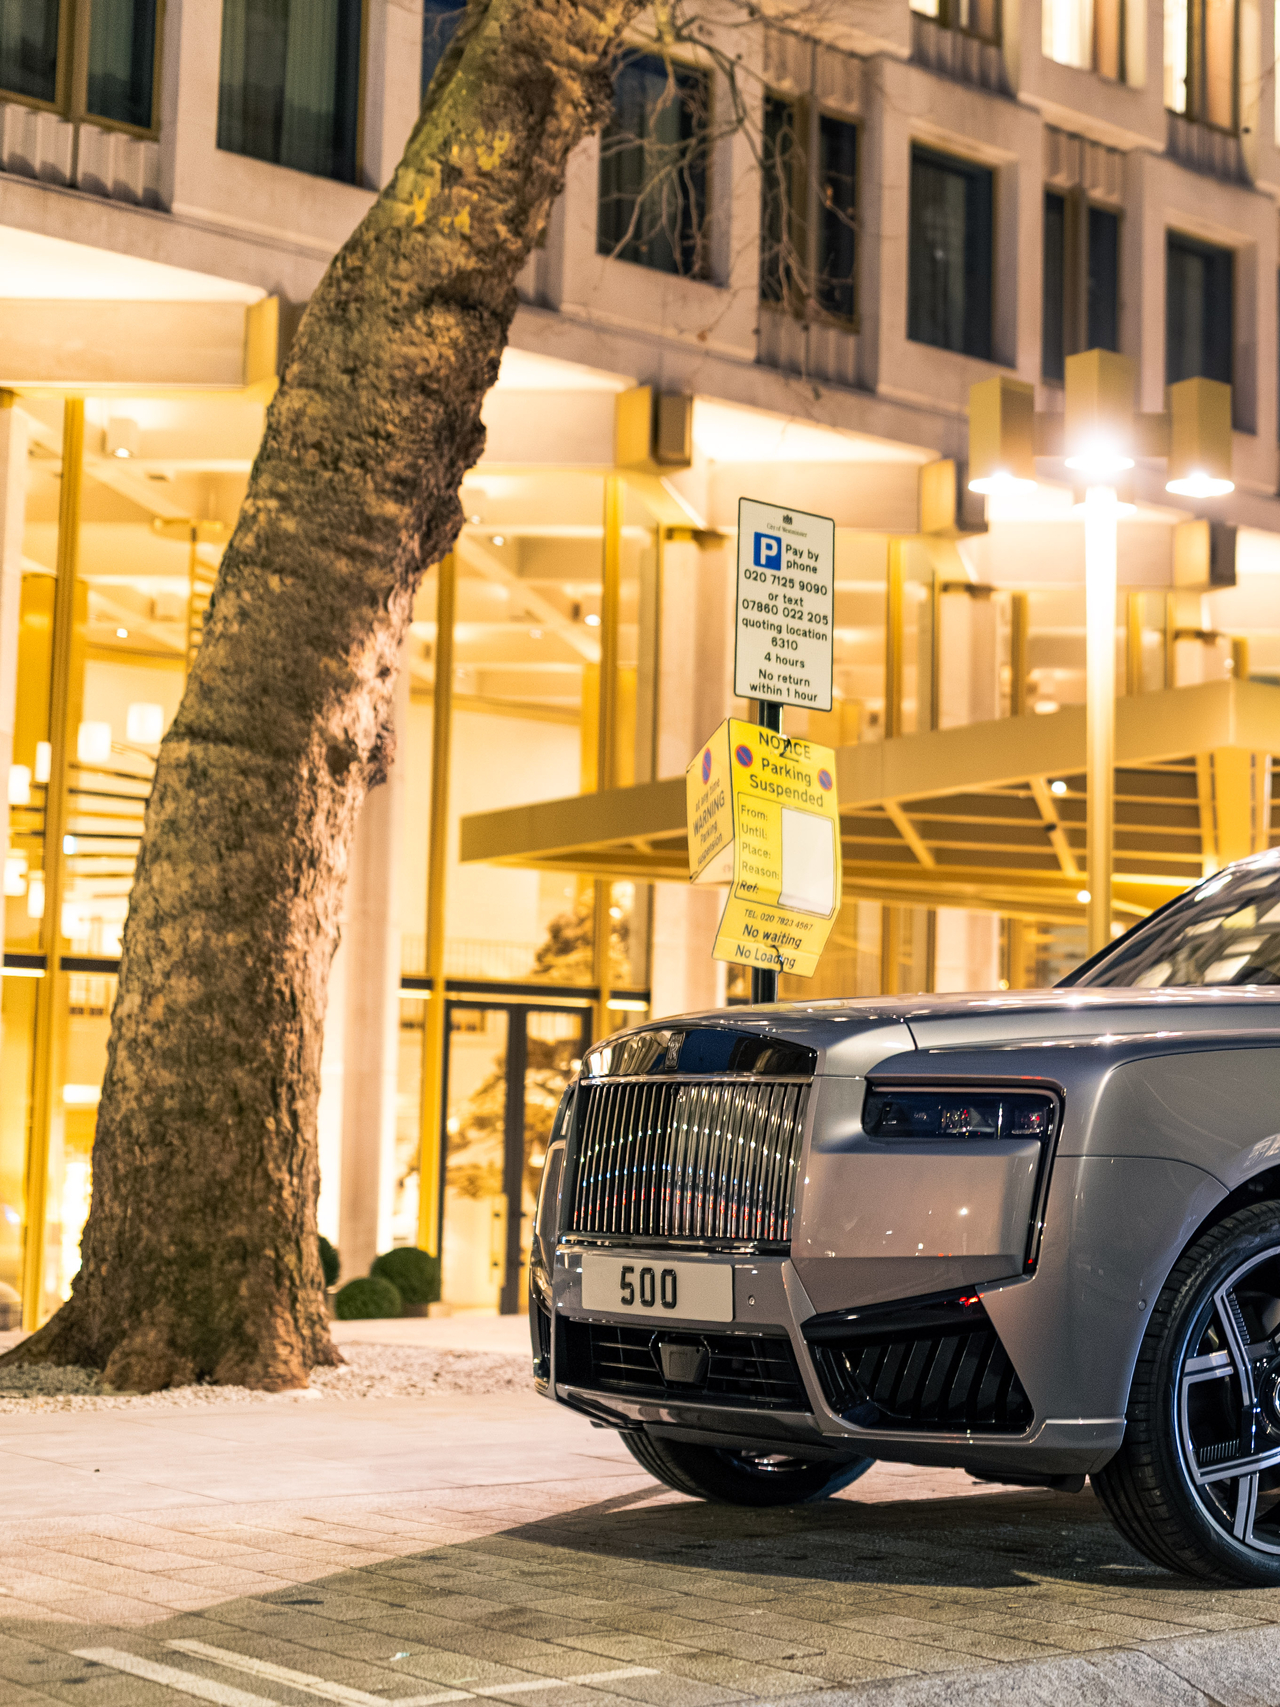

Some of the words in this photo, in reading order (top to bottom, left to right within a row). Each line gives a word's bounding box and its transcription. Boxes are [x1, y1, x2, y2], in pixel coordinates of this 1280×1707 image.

[761, 537, 778, 565] P
[786, 544, 804, 559] Pay
[807, 548, 819, 562] by
[786, 559, 818, 574] phone
[744, 569, 767, 583] 020
[770, 574, 795, 589] 7125
[798, 580, 827, 595] 9090
[768, 592, 779, 601] or
[783, 593, 803, 608] text
[742, 598, 778, 615] 07860
[782, 607, 804, 621] 022
[807, 612, 828, 626] 205
[742, 617, 782, 634] quoting
[786, 624, 827, 641] location
[764, 652, 772, 662] 4
[775, 653, 805, 668] hours
[758, 668, 773, 681] No
[777, 674, 810, 687] return
[749, 682, 782, 696] within
[786, 687, 790, 697] 1
[794, 689, 818, 702] hour
[758, 731, 811, 760] NOTICE
[761, 757, 811, 787] Parking
[749, 773, 824, 808] Suspended
[693, 790, 725, 837] WARNING
[741, 804, 768, 821] From:
[741, 823, 768, 840] Until:
[742, 842, 771, 859] Place:
[742, 860, 780, 880] Reason:
[740, 880, 759, 894] Ref:
[760, 912, 775, 922] 020
[776, 916, 794, 927] 7823
[795, 921, 814, 931] 4567
[742, 923, 759, 938] No
[762, 931, 802, 949] waiting
[735, 944, 751, 959] No
[754, 948, 796, 970] Loading
[620, 1265, 677, 1309] 500
